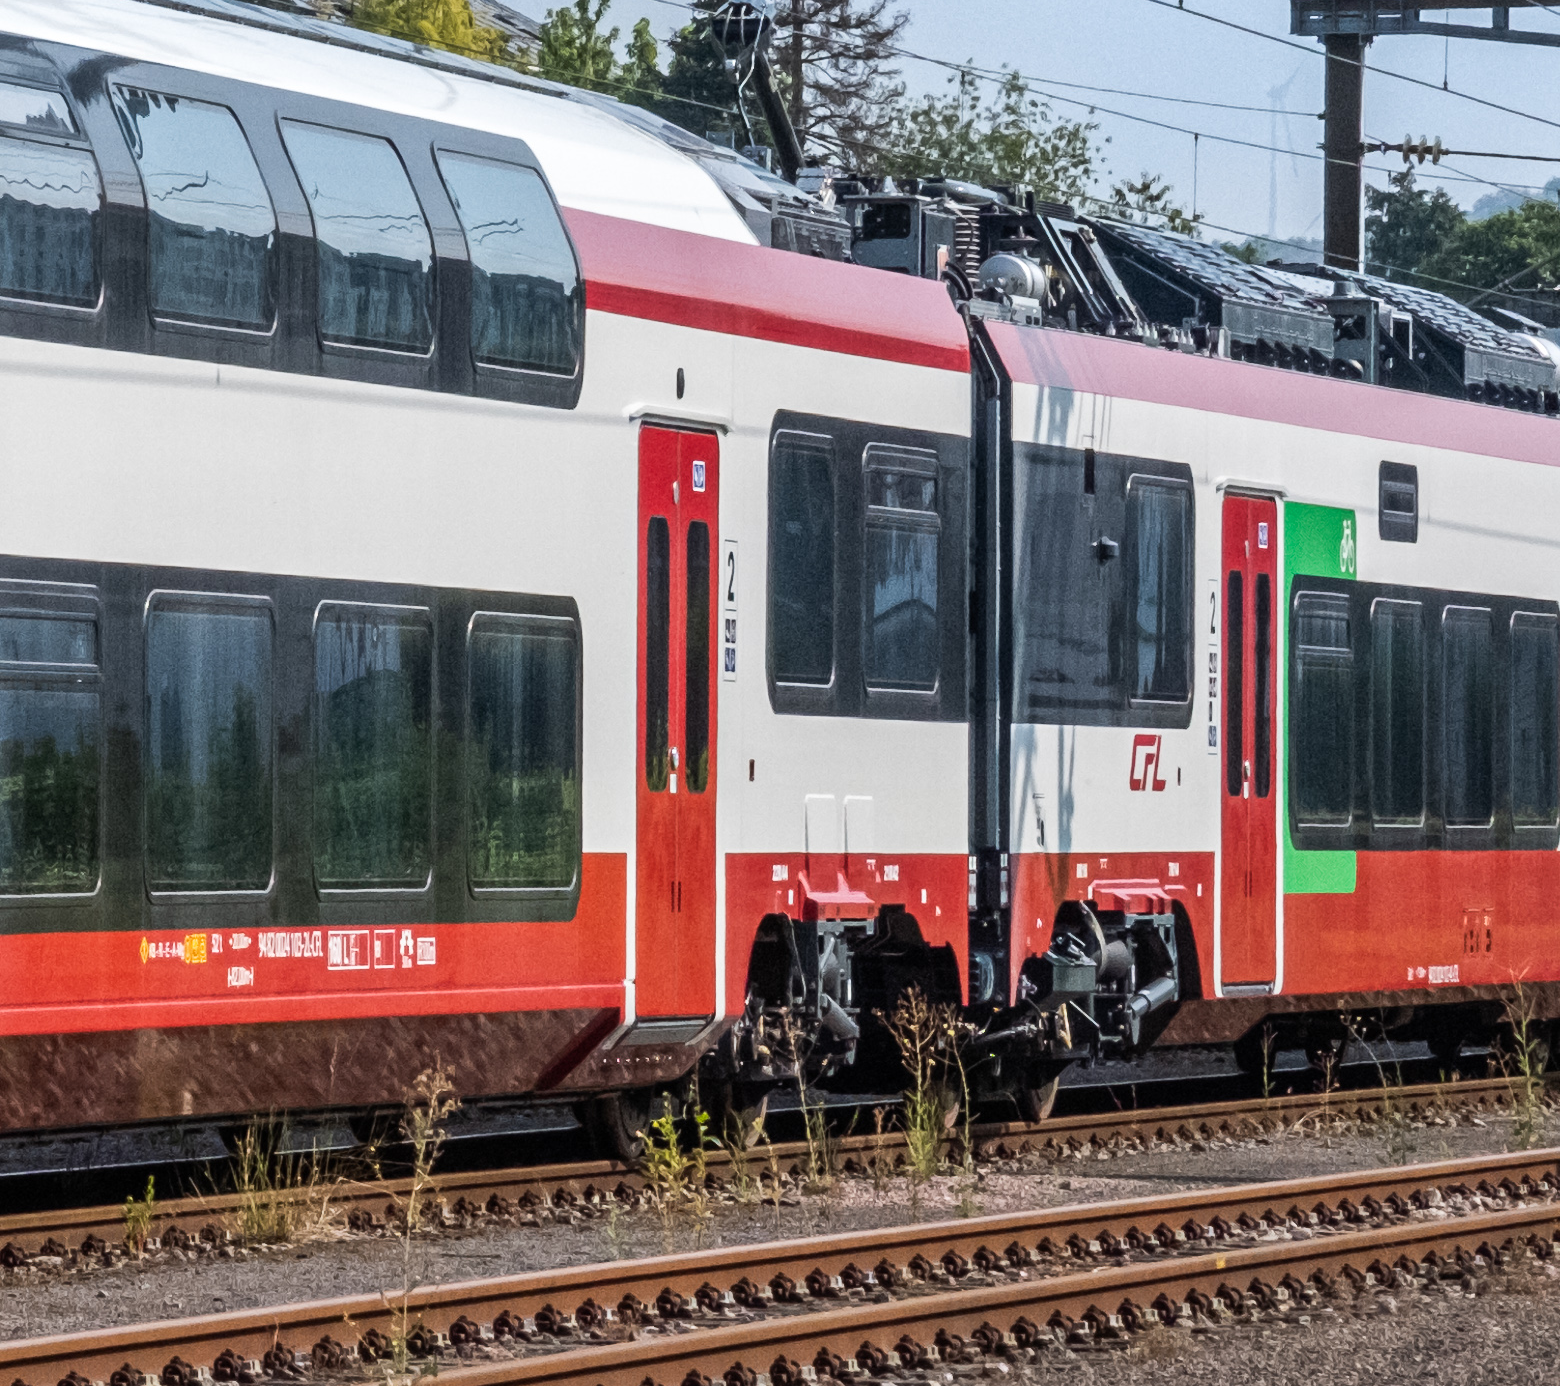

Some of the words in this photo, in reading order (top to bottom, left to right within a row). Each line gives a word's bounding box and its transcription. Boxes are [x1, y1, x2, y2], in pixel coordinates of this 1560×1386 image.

[727, 551, 735, 602] 2
[1210, 591, 1216, 634] 2
[1129, 734, 1166, 792] CFL
